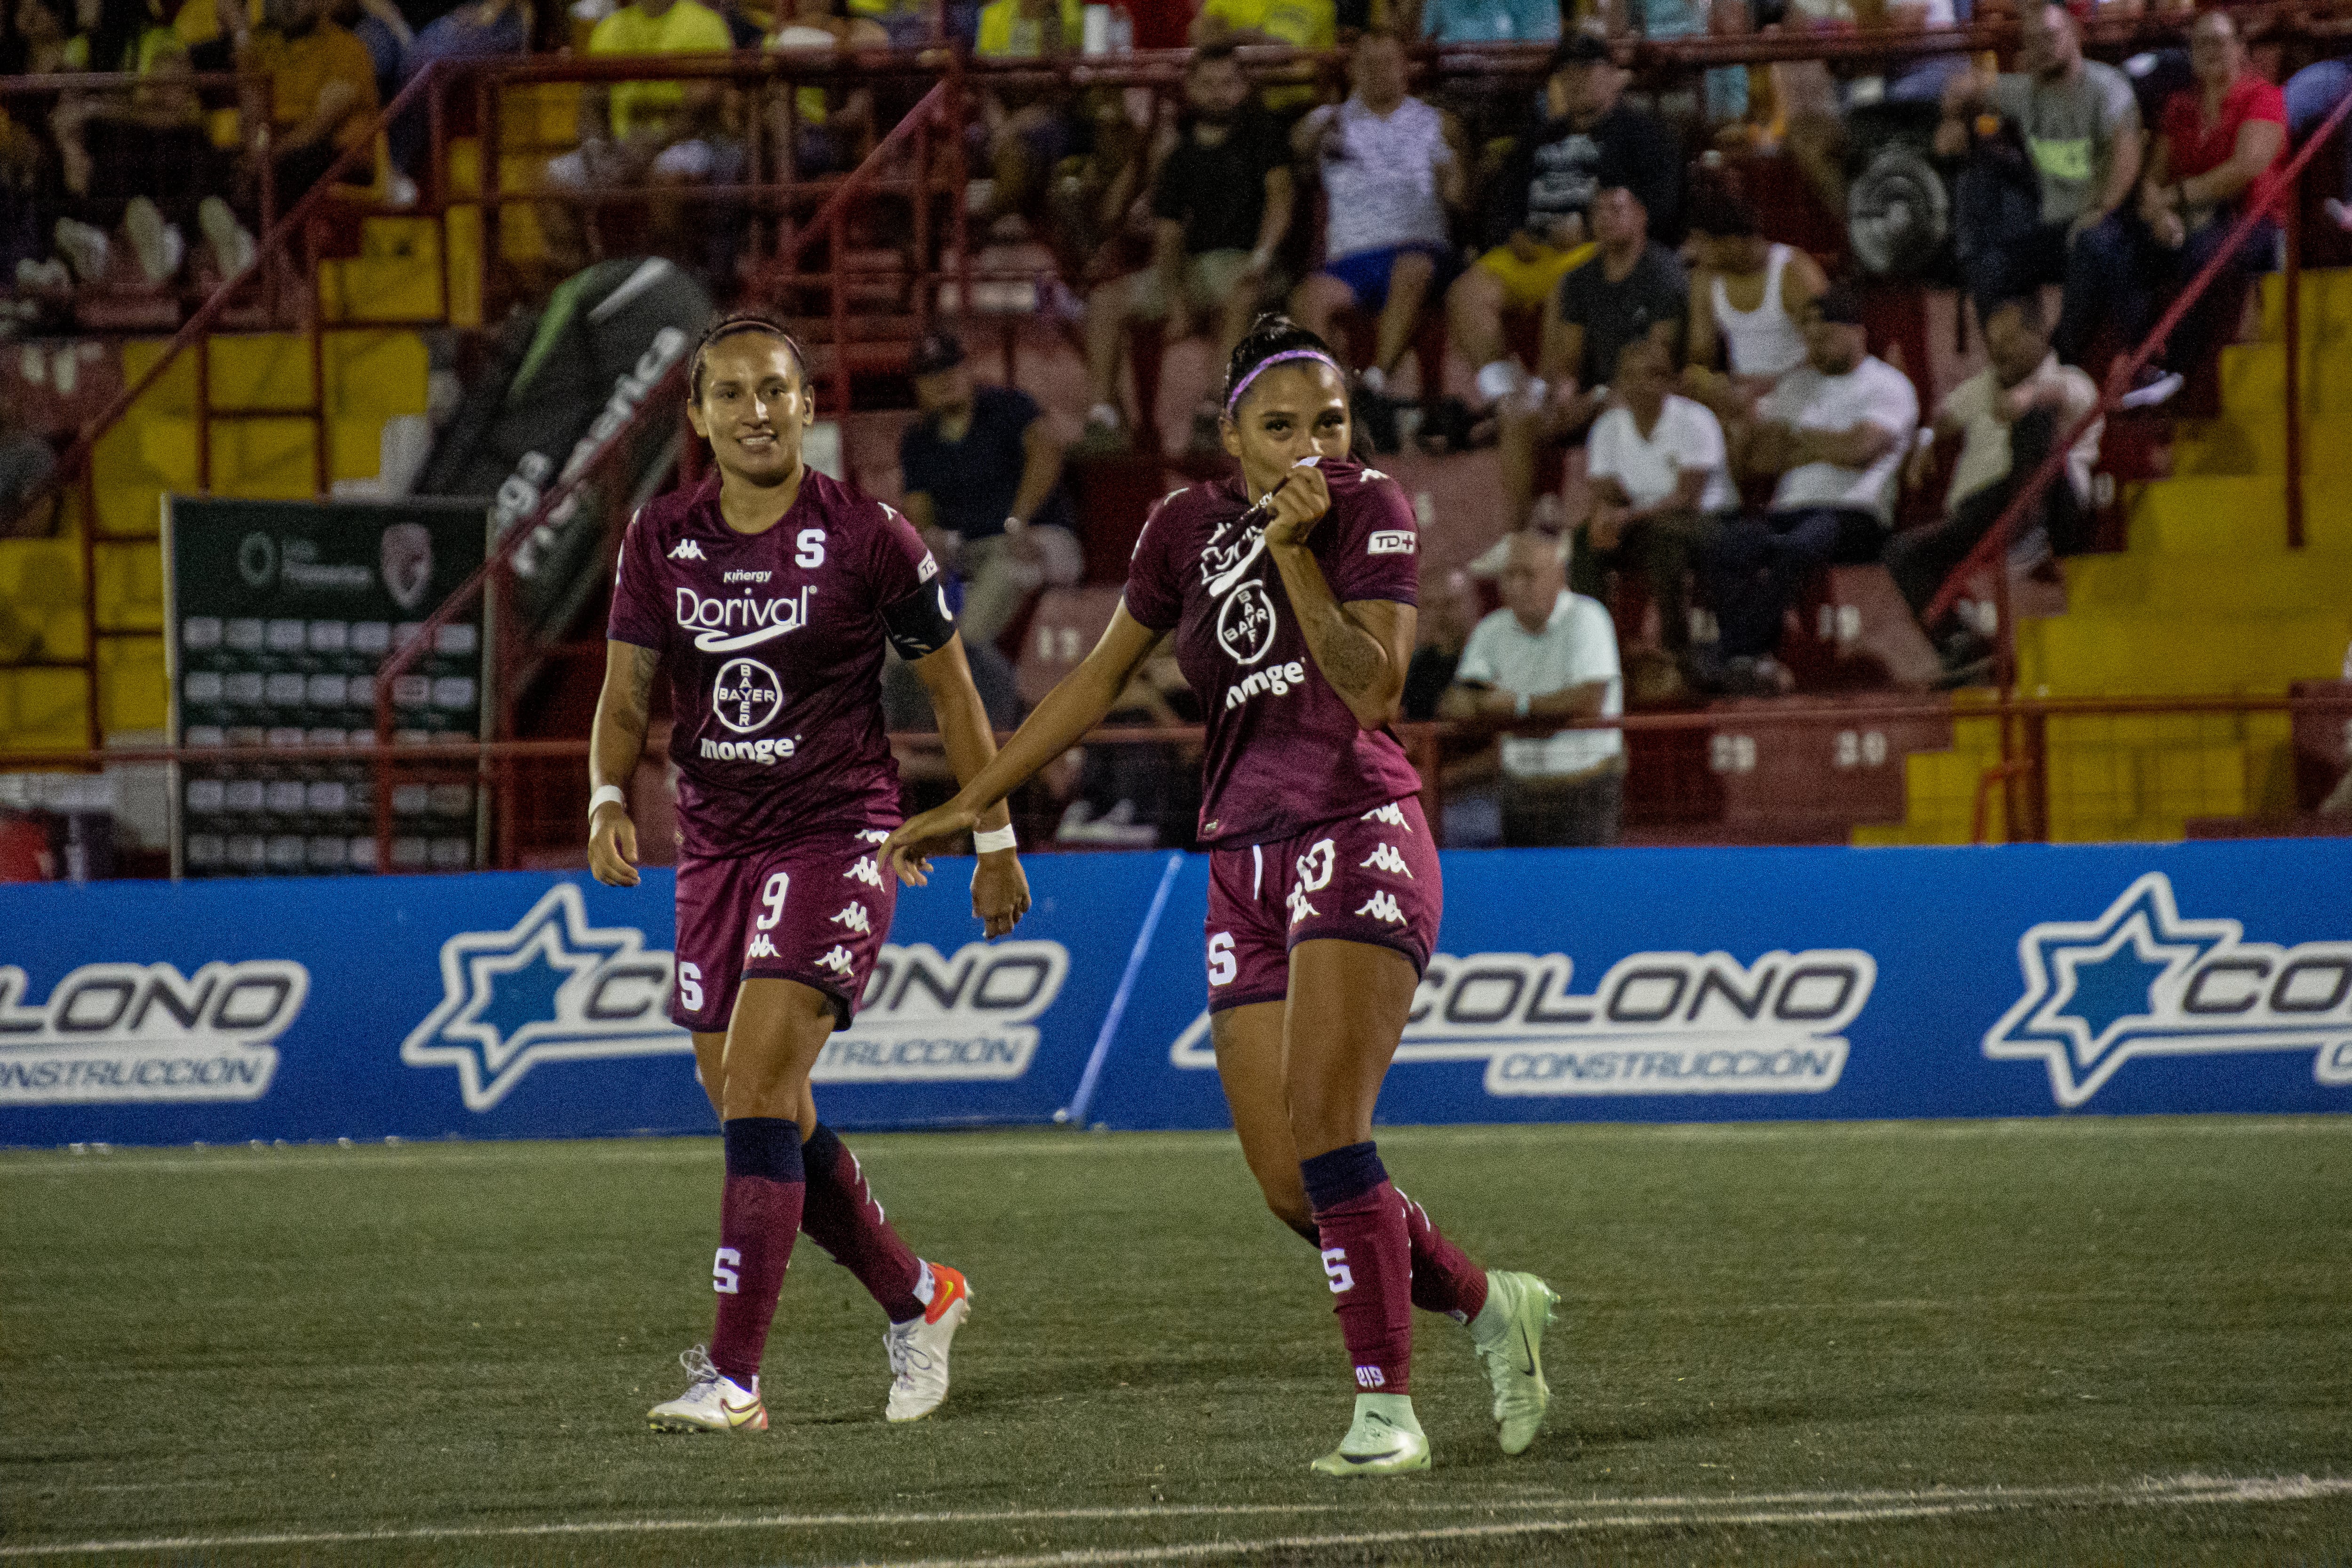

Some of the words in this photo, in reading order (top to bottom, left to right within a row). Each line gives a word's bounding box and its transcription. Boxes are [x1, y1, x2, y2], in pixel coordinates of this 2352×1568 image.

[795, 529, 826, 568] S
[719, 688, 775, 702] BAYER
[739, 664, 752, 726] BAYER
[700, 737, 794, 766] monge
[757, 872, 790, 930] 9
[1208, 931, 1237, 986] S
[678, 961, 703, 1011] S
[713, 1247, 741, 1294] S
[1321, 1248, 1355, 1294] S
